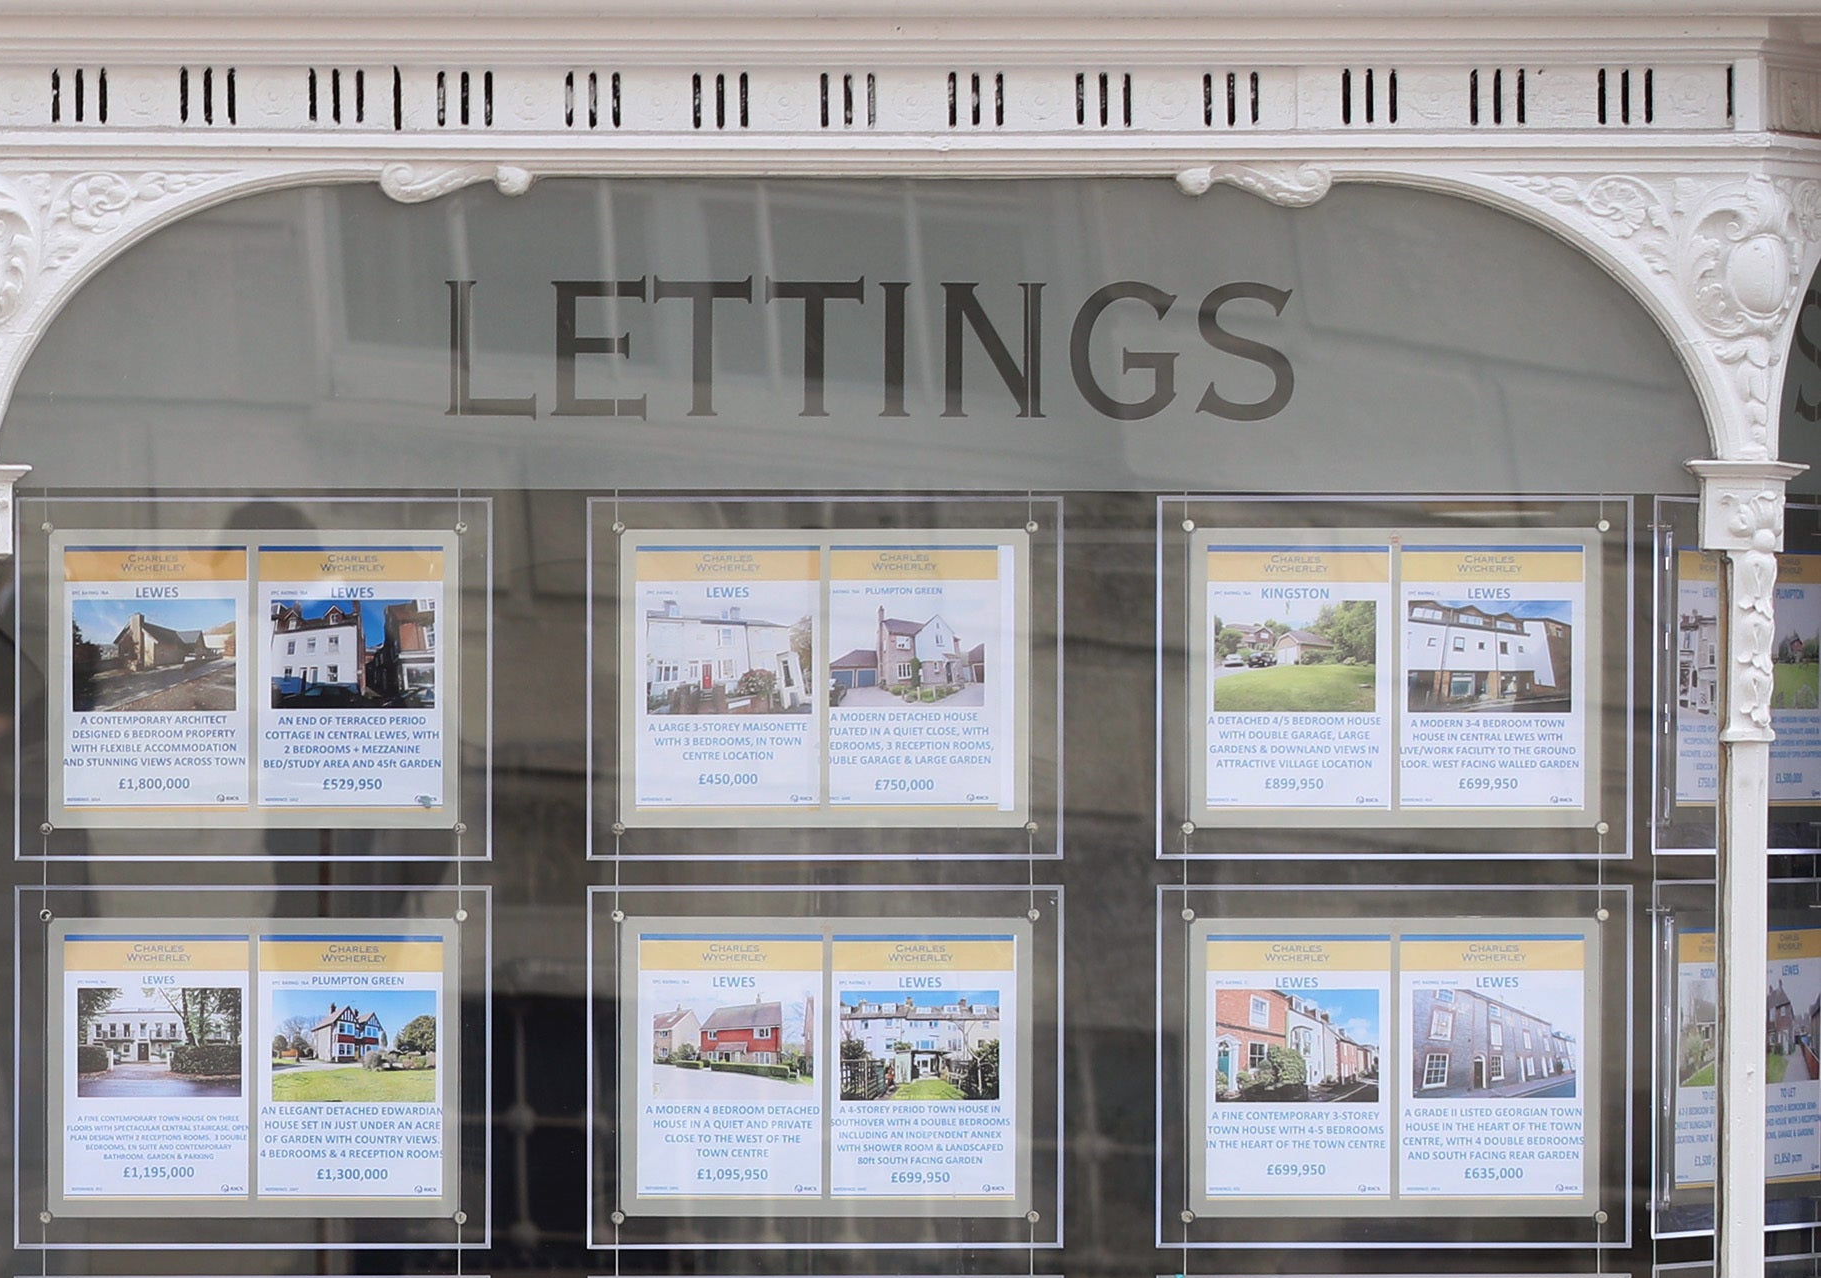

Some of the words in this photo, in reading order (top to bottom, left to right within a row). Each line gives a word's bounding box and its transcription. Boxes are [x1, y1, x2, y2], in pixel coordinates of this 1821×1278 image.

[444, 274, 1295, 421] LETTINGS
[135, 587, 179, 598] LEWES
[331, 587, 374, 598] LEWES
[707, 587, 749, 598] LEWES
[865, 587, 912, 595] PLUMPTON
[915, 587, 943, 595] GREEN
[1262, 588, 1329, 599] KINGSTON
[1467, 588, 1511, 599] LEWES
[81, 716, 88, 724] A
[90, 716, 172, 724] CONTEMPORARY
[175, 715, 227, 724] ARCHITECT
[119, 778, 190, 791] £1,800,000
[323, 779, 382, 791] £529,950
[699, 774, 758, 786] £450,000
[875, 779, 934, 792] £750,000
[1265, 778, 1324, 791] £899,950
[1459, 778, 1518, 791] £699,950
[143, 976, 175, 984] LEWES
[312, 976, 368, 985] PLUMPTON
[371, 976, 404, 985] GREEN
[713, 976, 755, 987] LEWES
[899, 977, 942, 988] LEWES
[1275, 977, 1318, 988] LEWES
[1476, 977, 1519, 988] LEWES
[696, 1149, 728, 1157] TOWN
[731, 1149, 768, 1157] CENTRE
[123, 1167, 194, 1179] £1,195,000
[317, 1169, 388, 1181] £1,300,000
[697, 1169, 768, 1182] £1,095,950
[1267, 1164, 1326, 1177] £699,950
[1465, 1168, 1523, 1180] £635,000
[891, 1172, 950, 1184] £699,950
